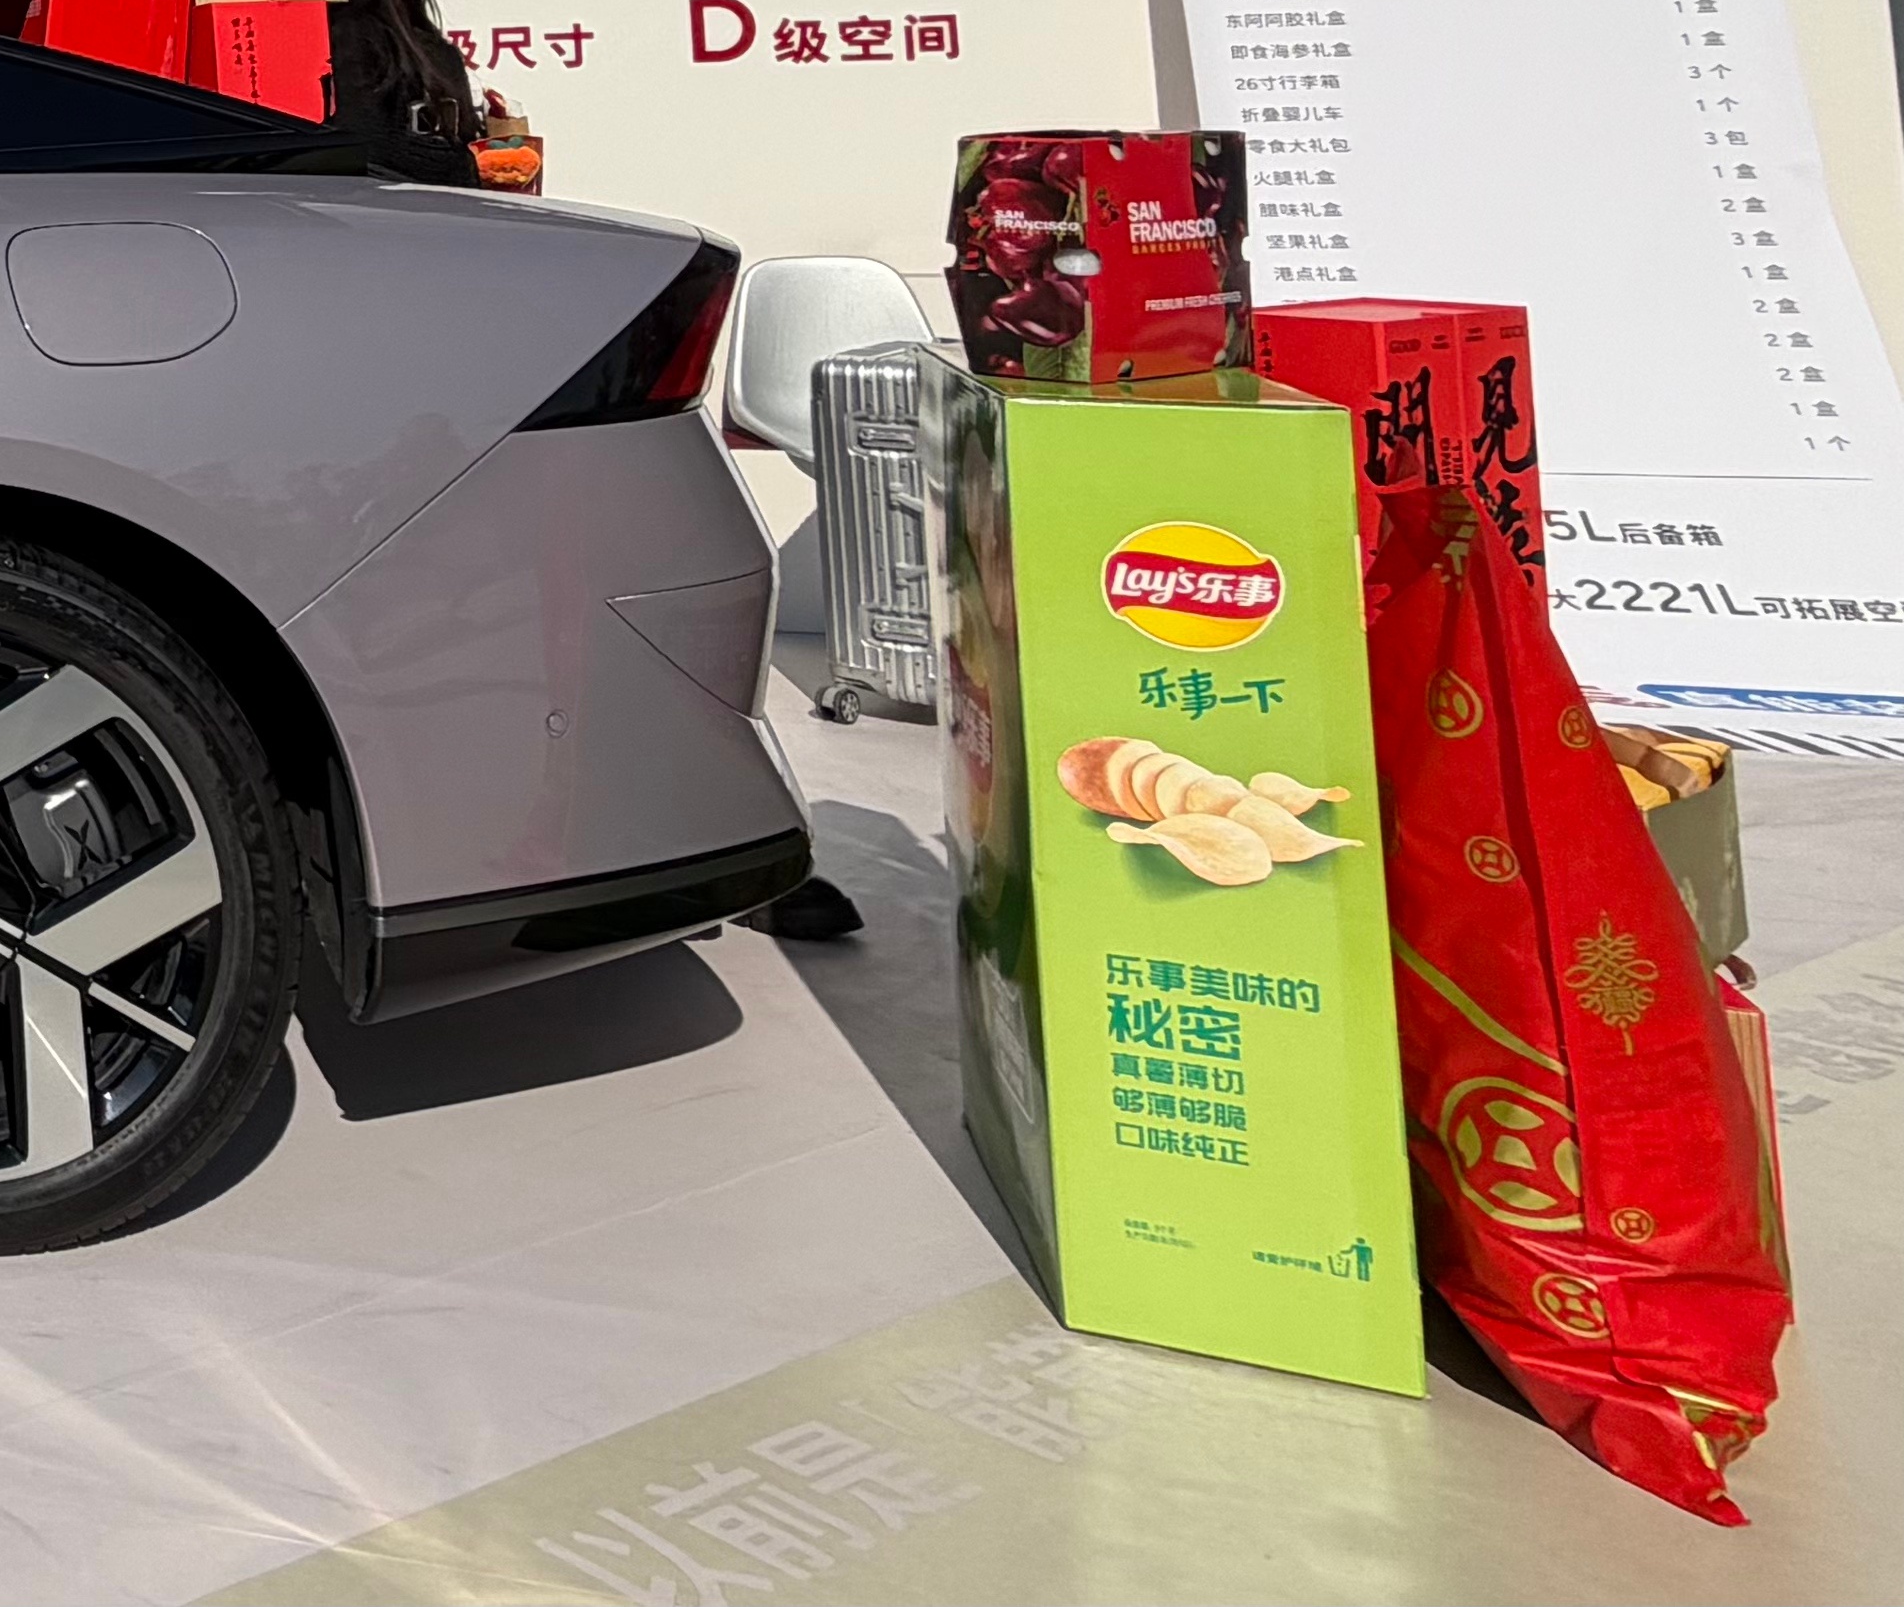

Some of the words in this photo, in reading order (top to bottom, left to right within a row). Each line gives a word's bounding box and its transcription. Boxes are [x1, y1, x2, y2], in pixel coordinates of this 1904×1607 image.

[1225, 9, 1347, 28] 东阿阿胶礼盒
[1229, 41, 1353, 60] 即食海参礼盒
[1234, 74, 1341, 91] 26寸行李箱
[1241, 105, 1344, 123] 折叠婴儿车
[1247, 137, 1352, 154] 零食大礼包
[995, 209, 1025, 220] SAN
[1126, 200, 1162, 221] SAN
[995, 216, 1080, 232] FRANCISCO
[1129, 216, 1217, 243] FRANCISCO
[1547, 578, 1904, 623] 大2221L可拓展空
[1138, 666, 1287, 720] 乐事一下
[1105, 952, 1321, 1014] 乐事美味的
[1105, 992, 1243, 1062] 秘密
[1110, 1051, 1245, 1096] 真薯薄切
[1112, 1086, 1248, 1132] 够薄够脆
[1114, 1121, 1250, 1167] 口味纯正
